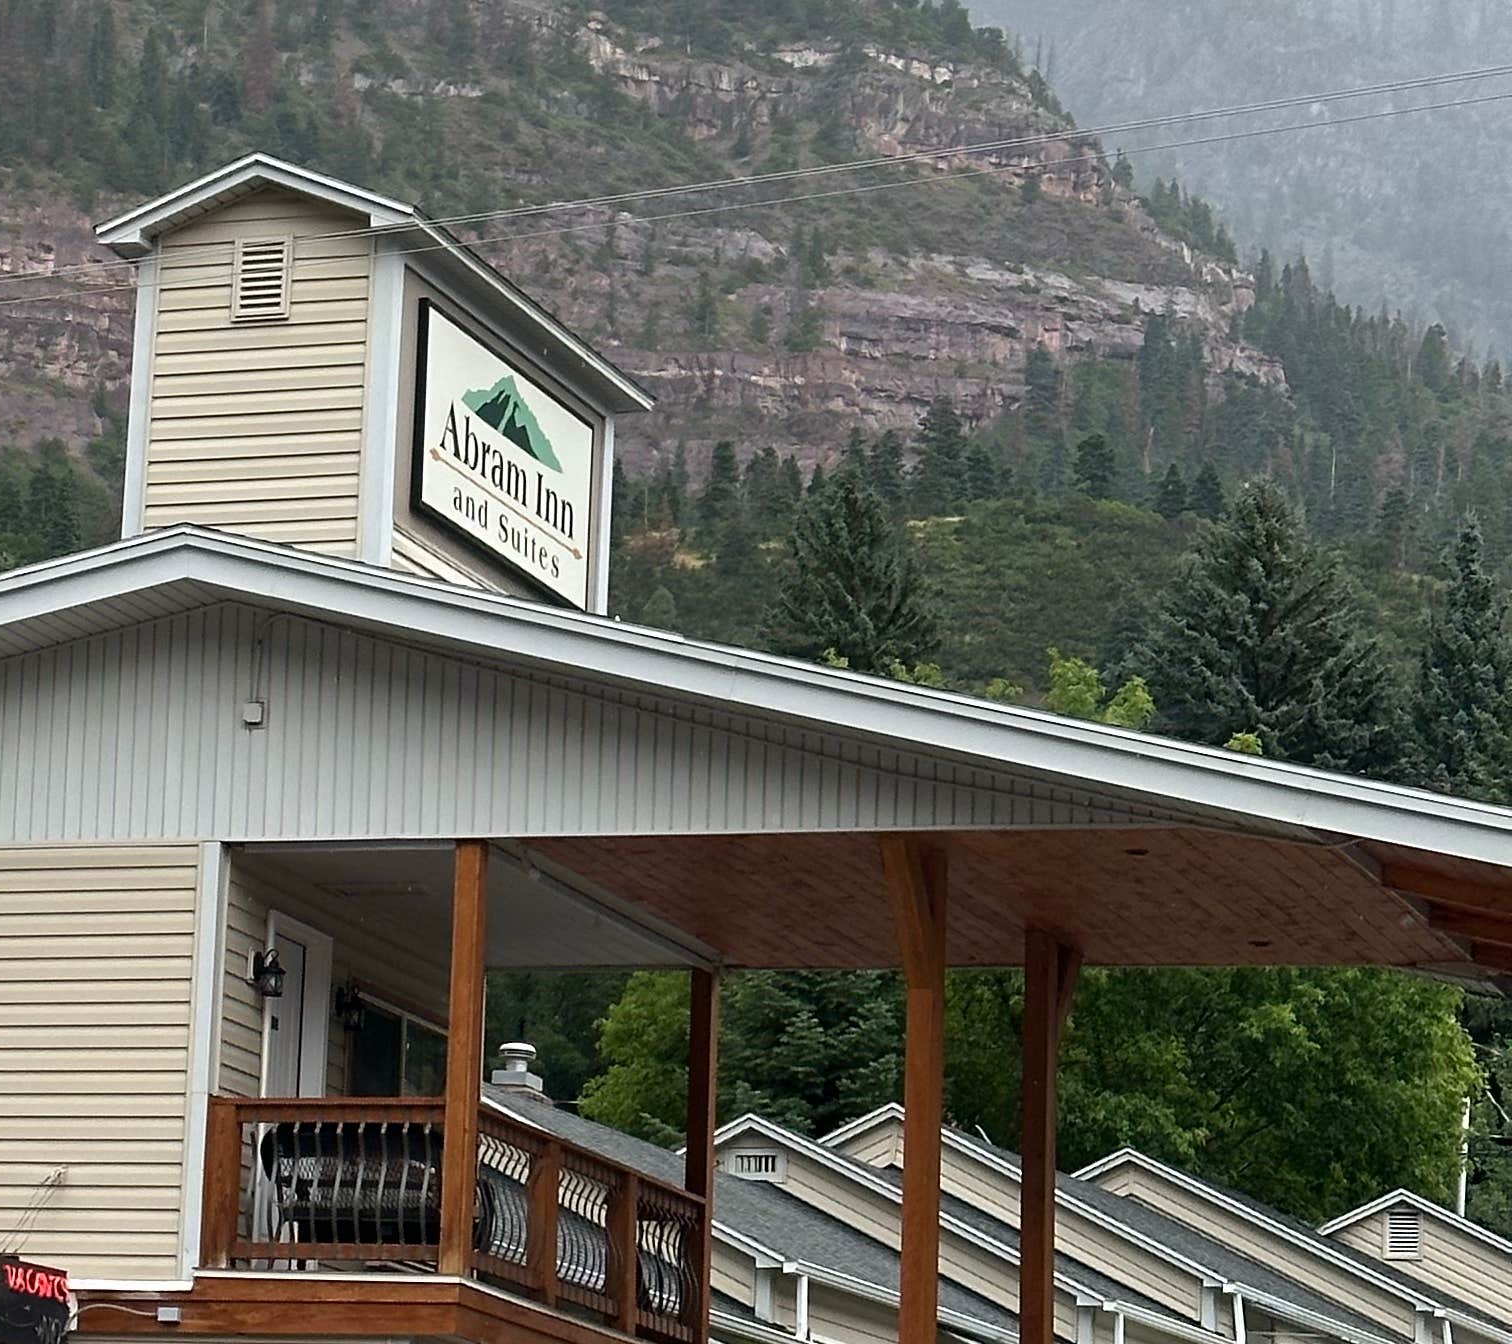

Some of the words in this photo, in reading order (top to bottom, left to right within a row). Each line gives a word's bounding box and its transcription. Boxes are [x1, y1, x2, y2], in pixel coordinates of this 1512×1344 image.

[440, 400, 528, 507] Abram
[536, 471, 574, 540] Inn
[453, 486, 488, 529] and
[498, 513, 561, 579] Suites
